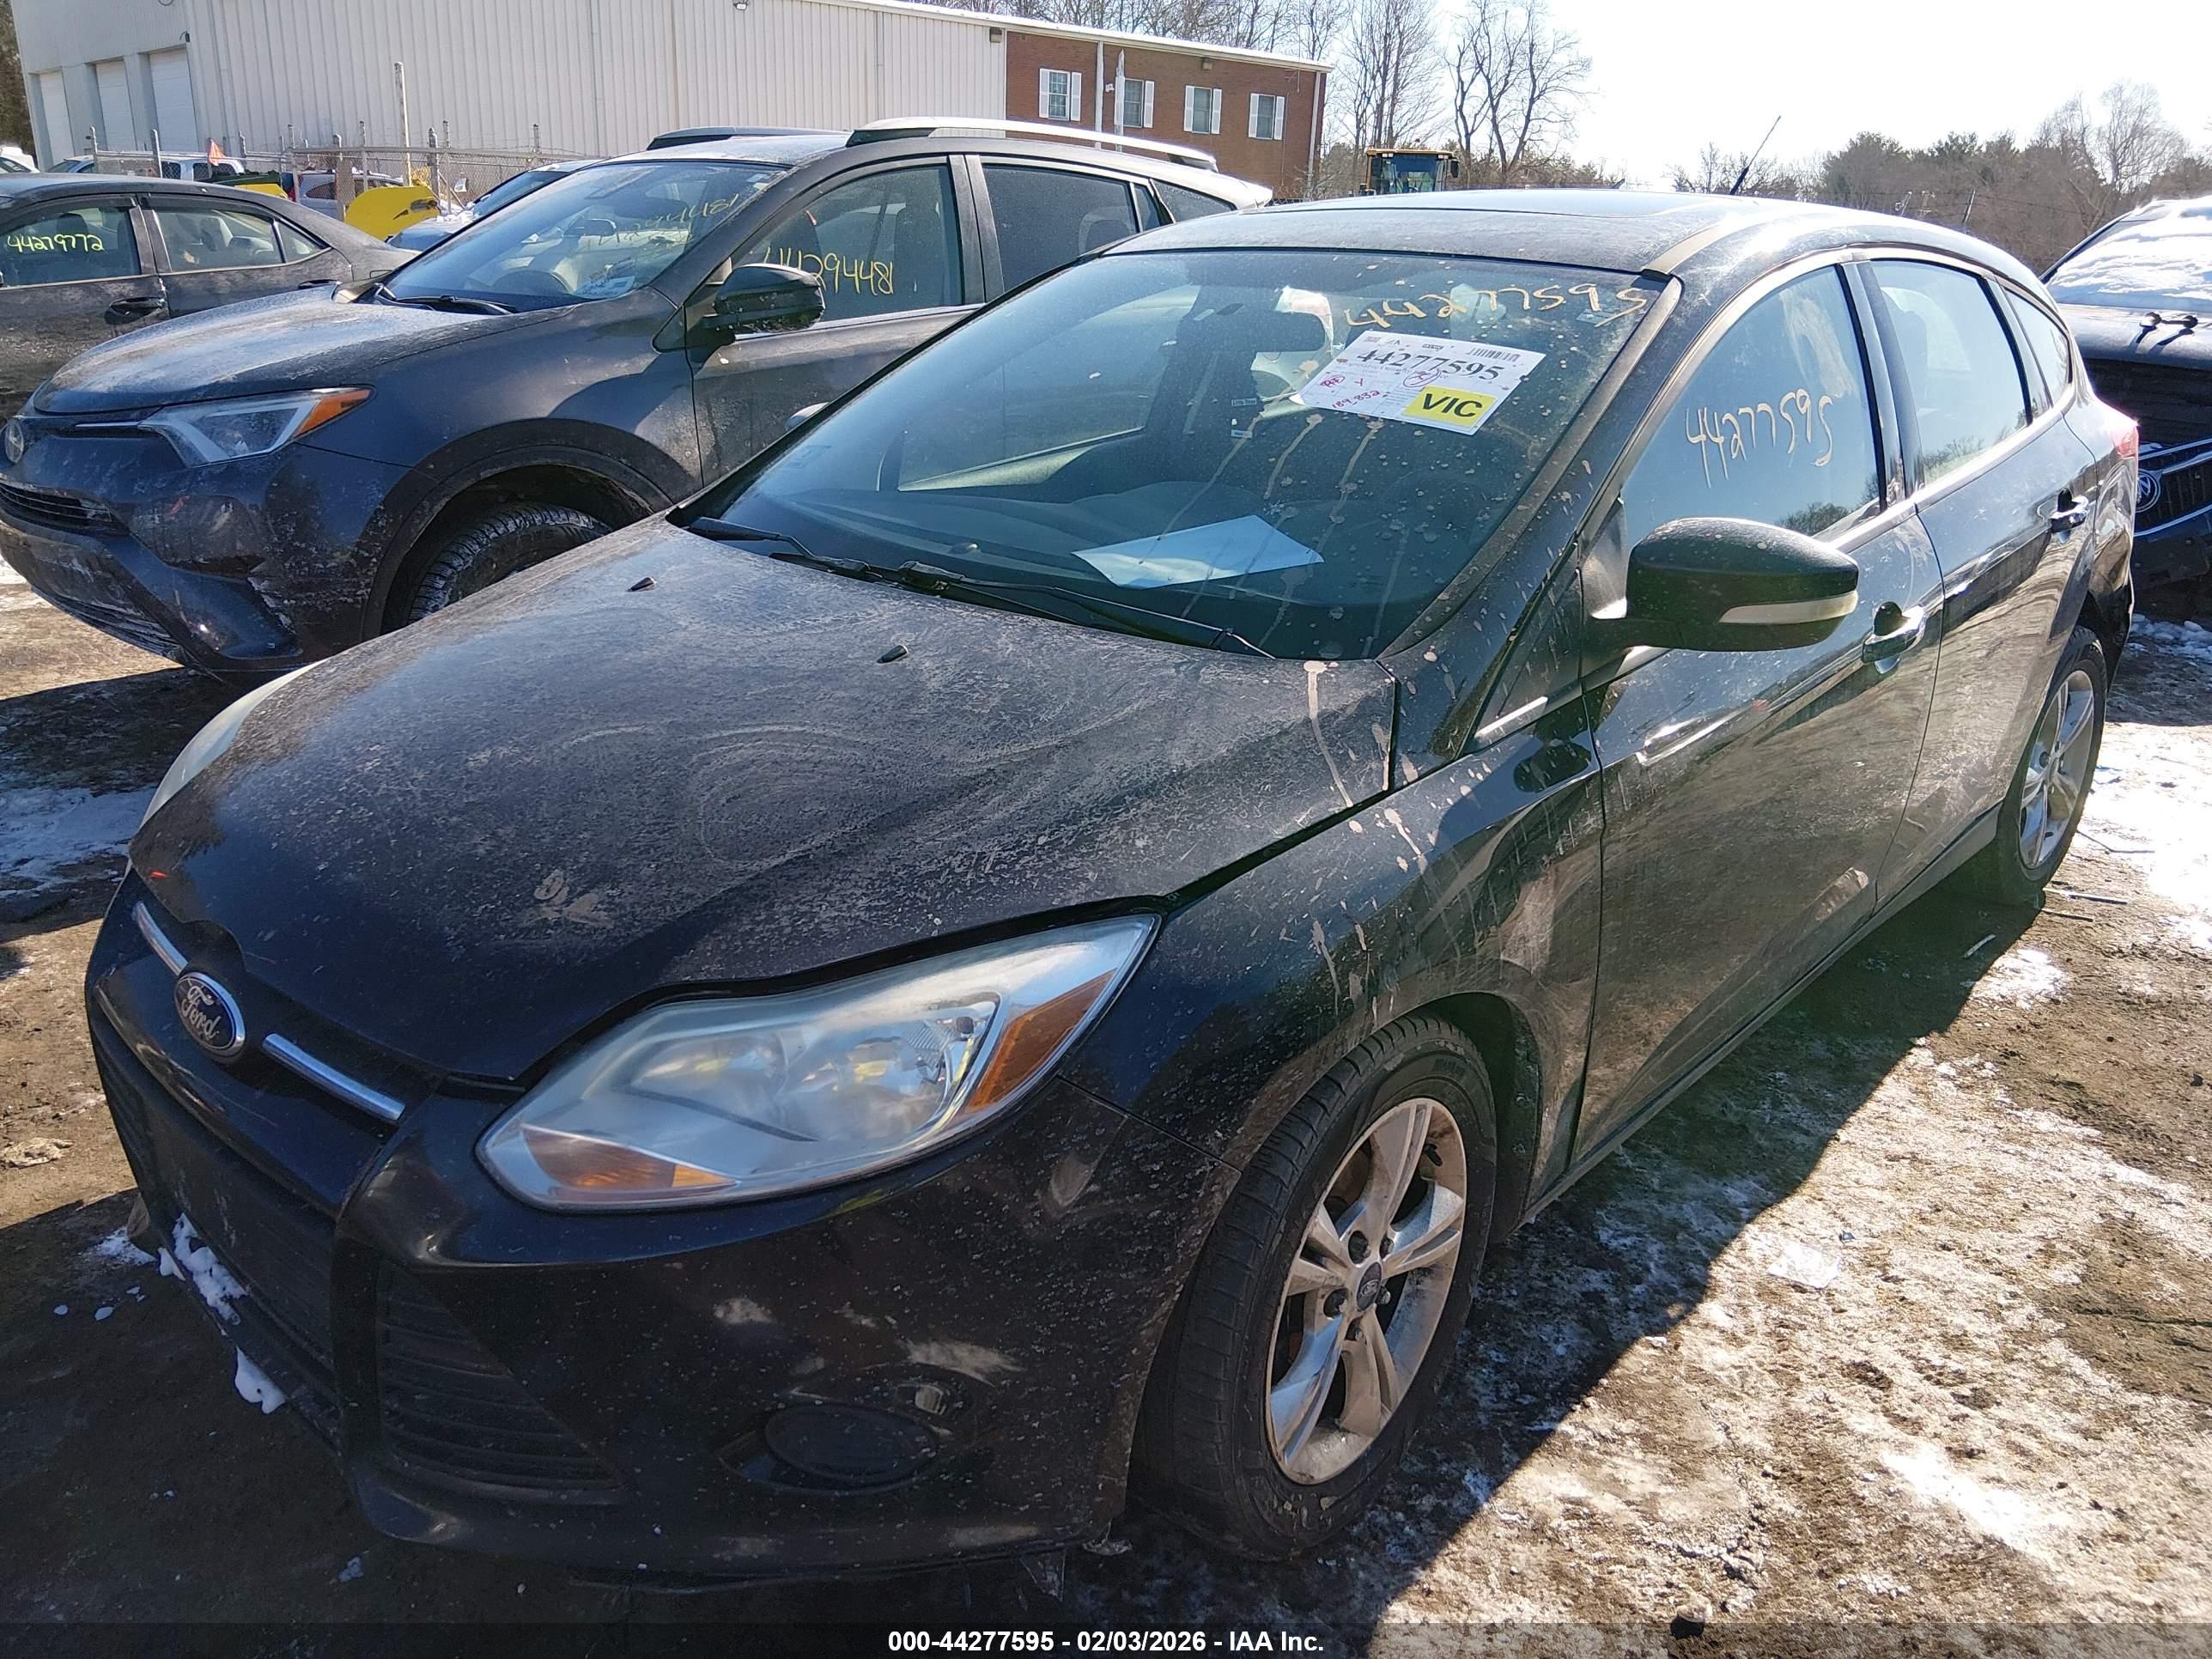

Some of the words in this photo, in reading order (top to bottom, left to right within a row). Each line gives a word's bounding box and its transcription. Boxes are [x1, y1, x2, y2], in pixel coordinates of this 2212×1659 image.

[7, 233, 105, 253] 44279772
[1343, 283, 1647, 329] 44277595
[1356, 349, 1505, 380] 44277595
[1422, 392, 1483, 417] VIC
[1686, 388, 1834, 489] 44277595
[180, 985, 222, 1041] Ford
